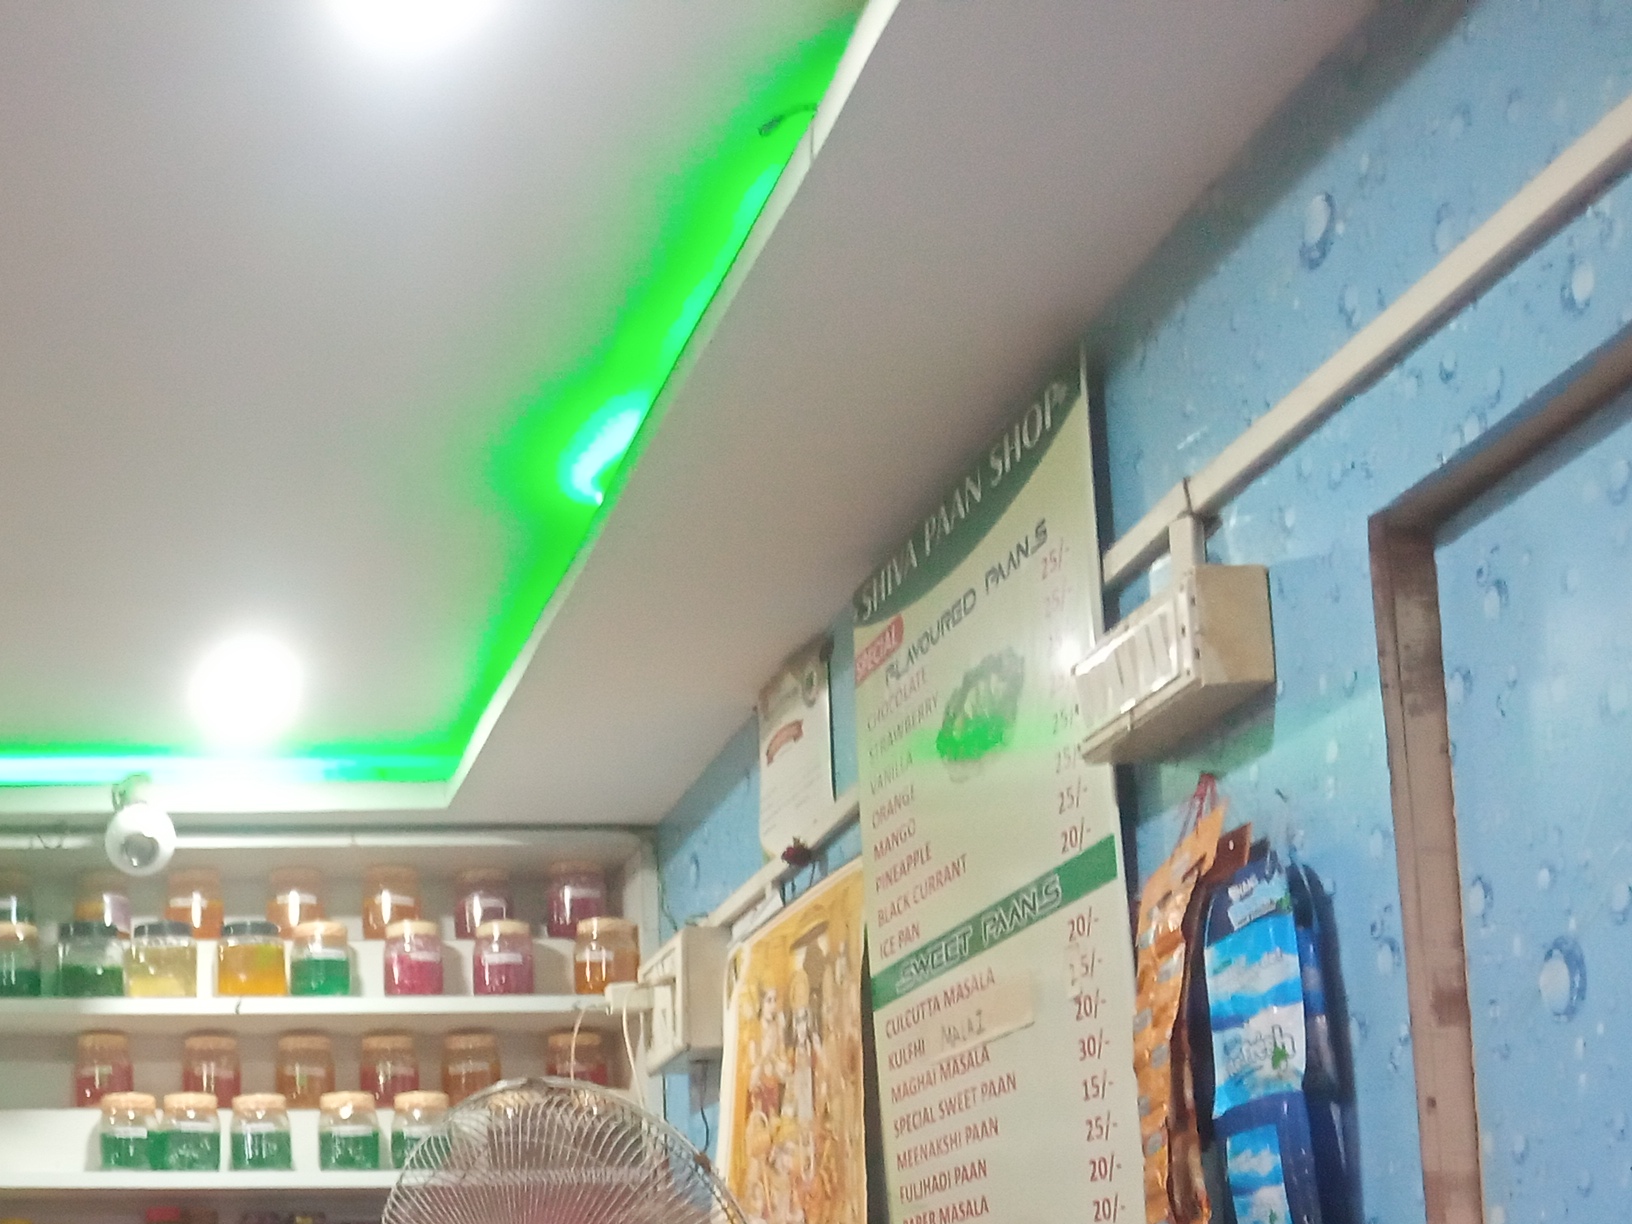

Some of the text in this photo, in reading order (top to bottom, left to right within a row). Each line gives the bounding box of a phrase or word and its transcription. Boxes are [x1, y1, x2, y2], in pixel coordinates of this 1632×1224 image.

[856, 381, 1068, 621] SHIVA PAAN SHOP
[870, 750, 913, 796] VANILLA
[1059, 776, 1088, 815] 25/-
[873, 817, 917, 861] MANGO
[1061, 817, 1091, 855] 20/-
[875, 842, 932, 893] PINEAPPLE
[877, 854, 968, 928] BLACK CURRANT
[879, 922, 921, 960] ICE PAN
[1067, 906, 1099, 942] 20/-
[895, 925, 973, 995] SWEET
[885, 967, 996, 1039] CULCUTTA MASALA
[1078, 1028, 1110, 1061] 30/-
[891, 1044, 991, 1104] MAGHAI MASALA
[1082, 1069, 1114, 1101] 15/-
[893, 1071, 1017, 1139] SPECIAL SWEET PAAN
[896, 1116, 999, 1172] MEENAKSHI PAAN
[1085, 1110, 1118, 1142] 25/-
[954, 1159, 988, 1184] PAAN
[1089, 1152, 1122, 1182] 20/-
[1093, 1193, 1126, 1223] 20/-
